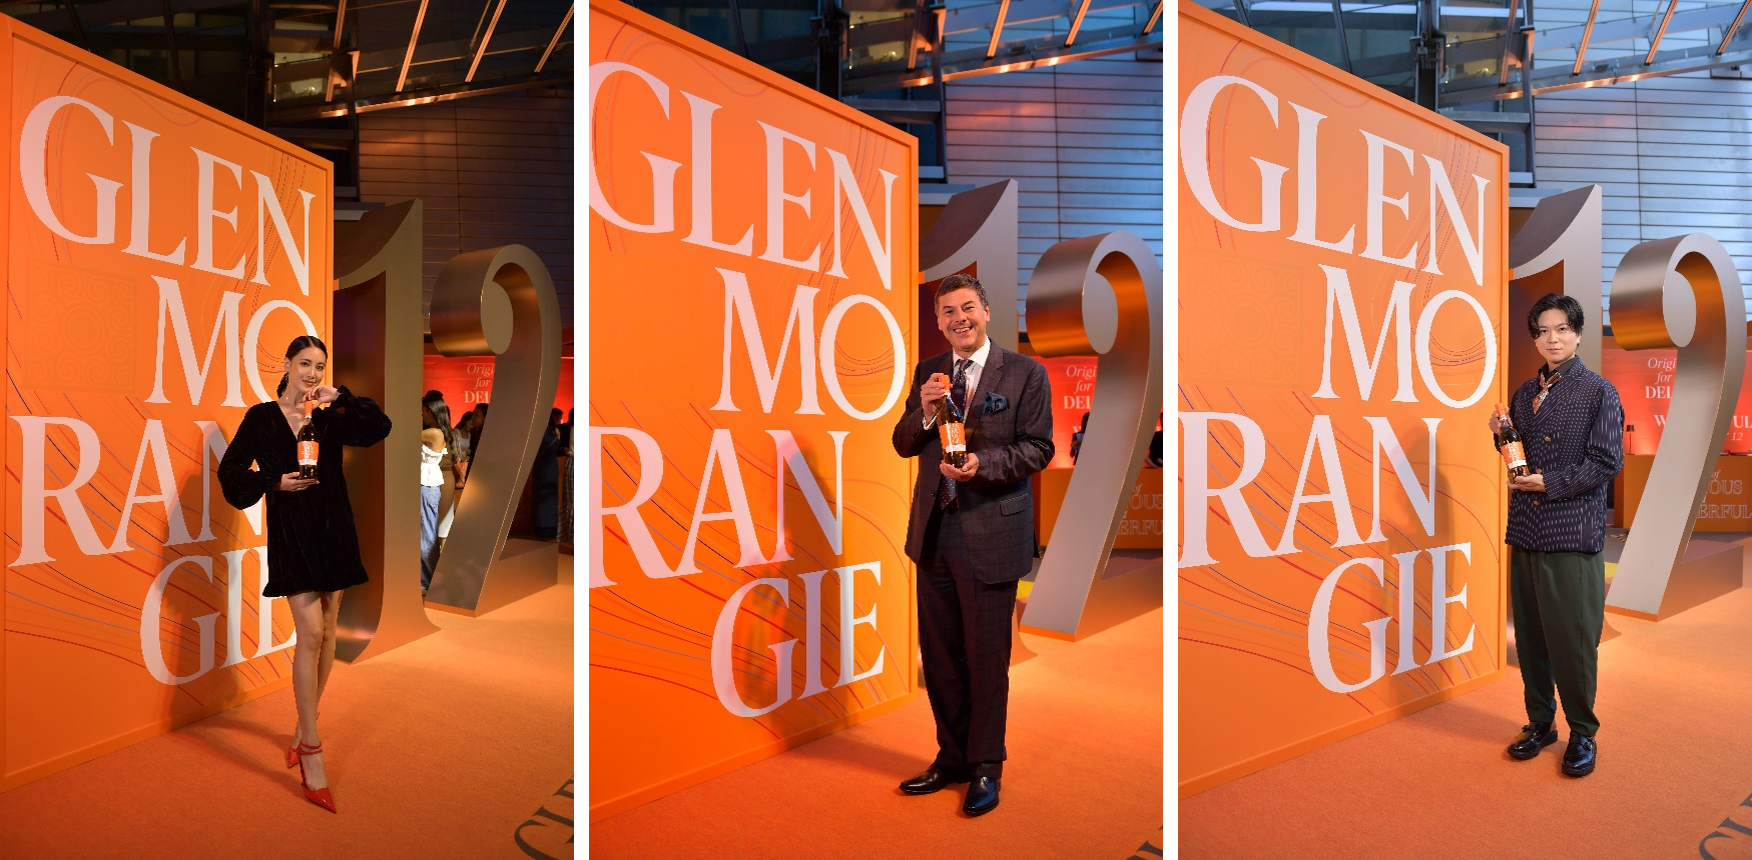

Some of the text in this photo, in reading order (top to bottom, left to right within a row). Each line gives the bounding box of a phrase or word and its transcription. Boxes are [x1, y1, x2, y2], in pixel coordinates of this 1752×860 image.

[20, 96, 315, 297] GLEN
[589, 61, 899, 291] GLEN
[1180, 74, 1491, 287] GLEN
[145, 275, 319, 408] MO
[474, 377, 491, 390] for
[710, 267, 907, 420] MO
[1074, 380, 1092, 394] for
[1311, 264, 1497, 409] MO
[1655, 371, 1673, 385] for
[9, 416, 267, 567] RAN
[589, 426, 851, 589] RAN
[1178, 411, 1444, 569] RAN
[711, 561, 885, 718] GIE
[1308, 542, 1475, 694] GIE
